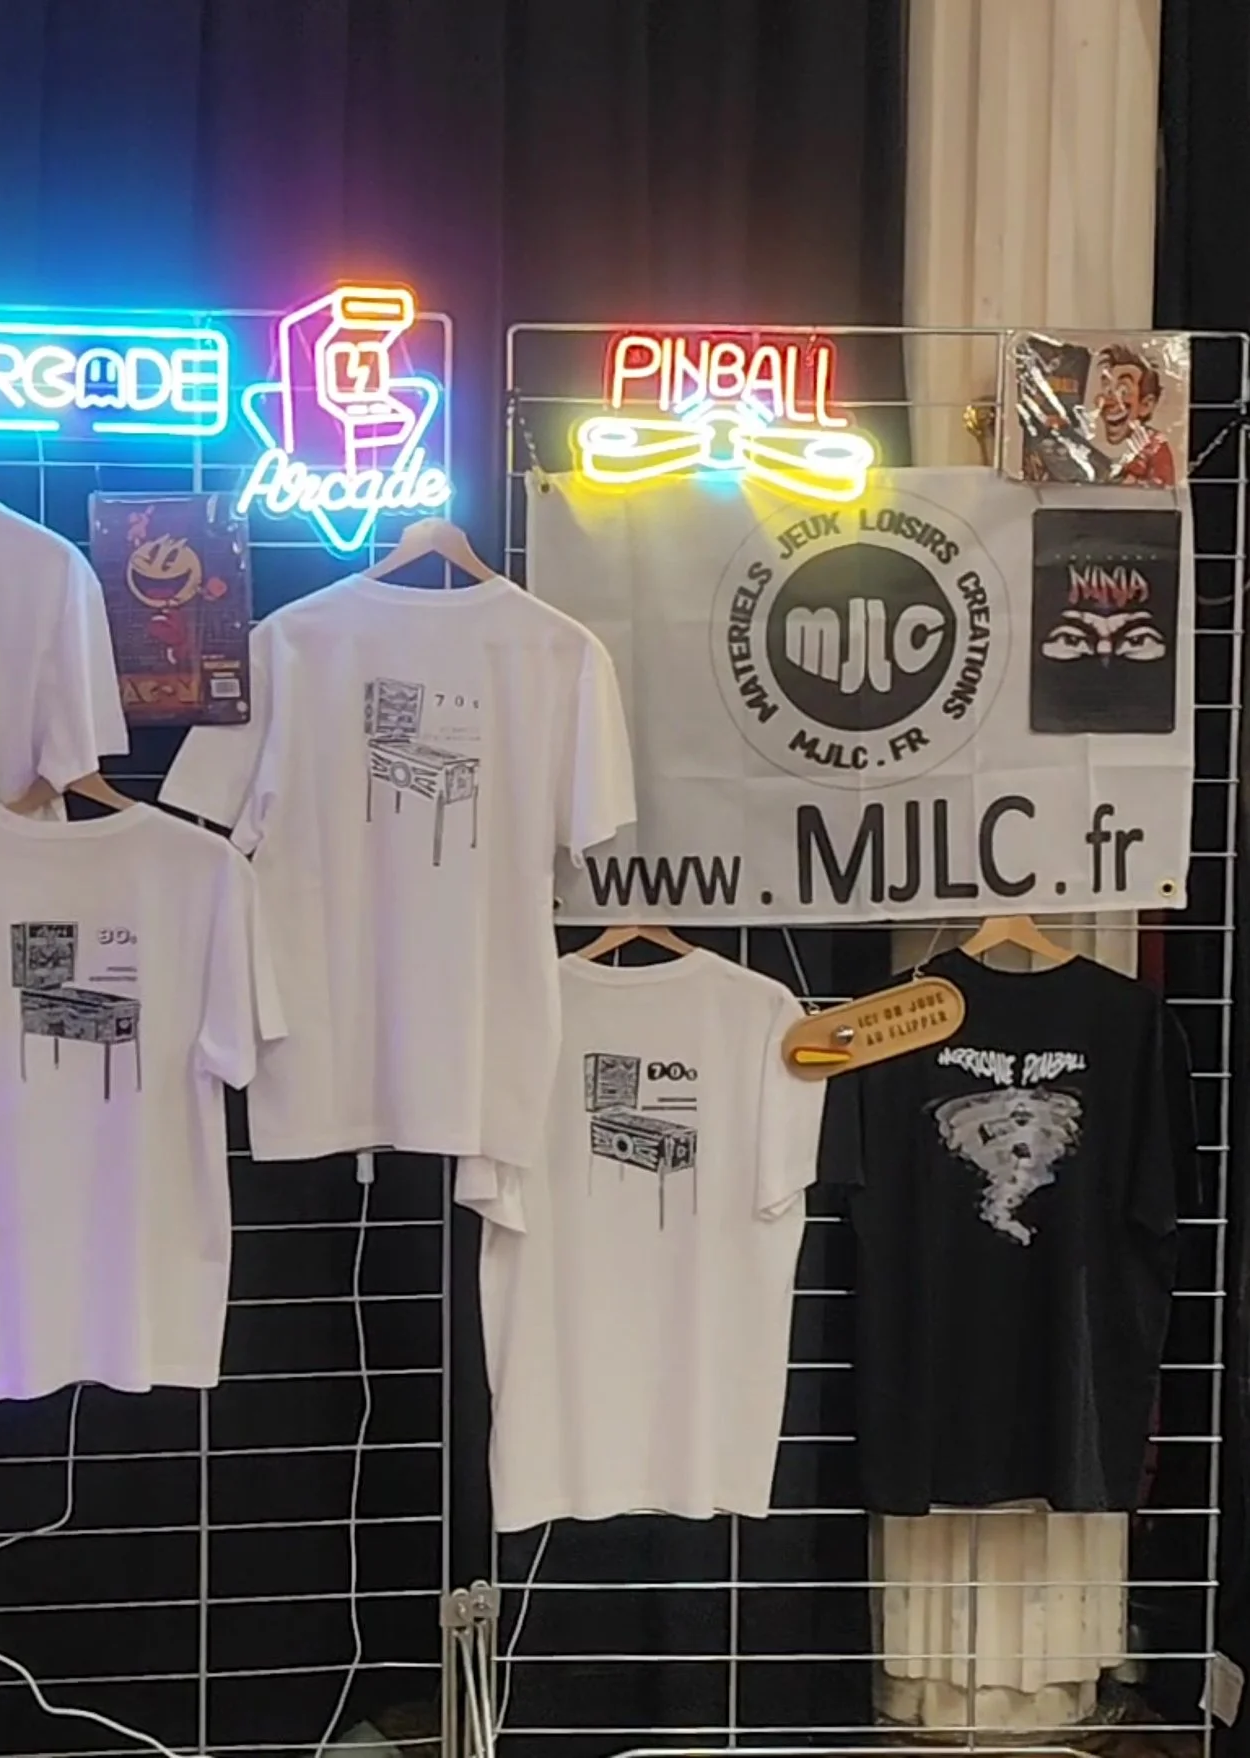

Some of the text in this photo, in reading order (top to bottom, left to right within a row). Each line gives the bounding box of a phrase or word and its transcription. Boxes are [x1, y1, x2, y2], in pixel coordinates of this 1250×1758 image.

[611, 335, 849, 428] PINBALL
[236, 446, 453, 514] Arcade
[1068, 564, 1148, 608] NINJA
[727, 507, 991, 724] MATERIELS JEUX LOISIRS CREATIONS
[888, 1009, 948, 1039] FLIPPER
[1021, 1052, 1087, 1087] PINBALL
